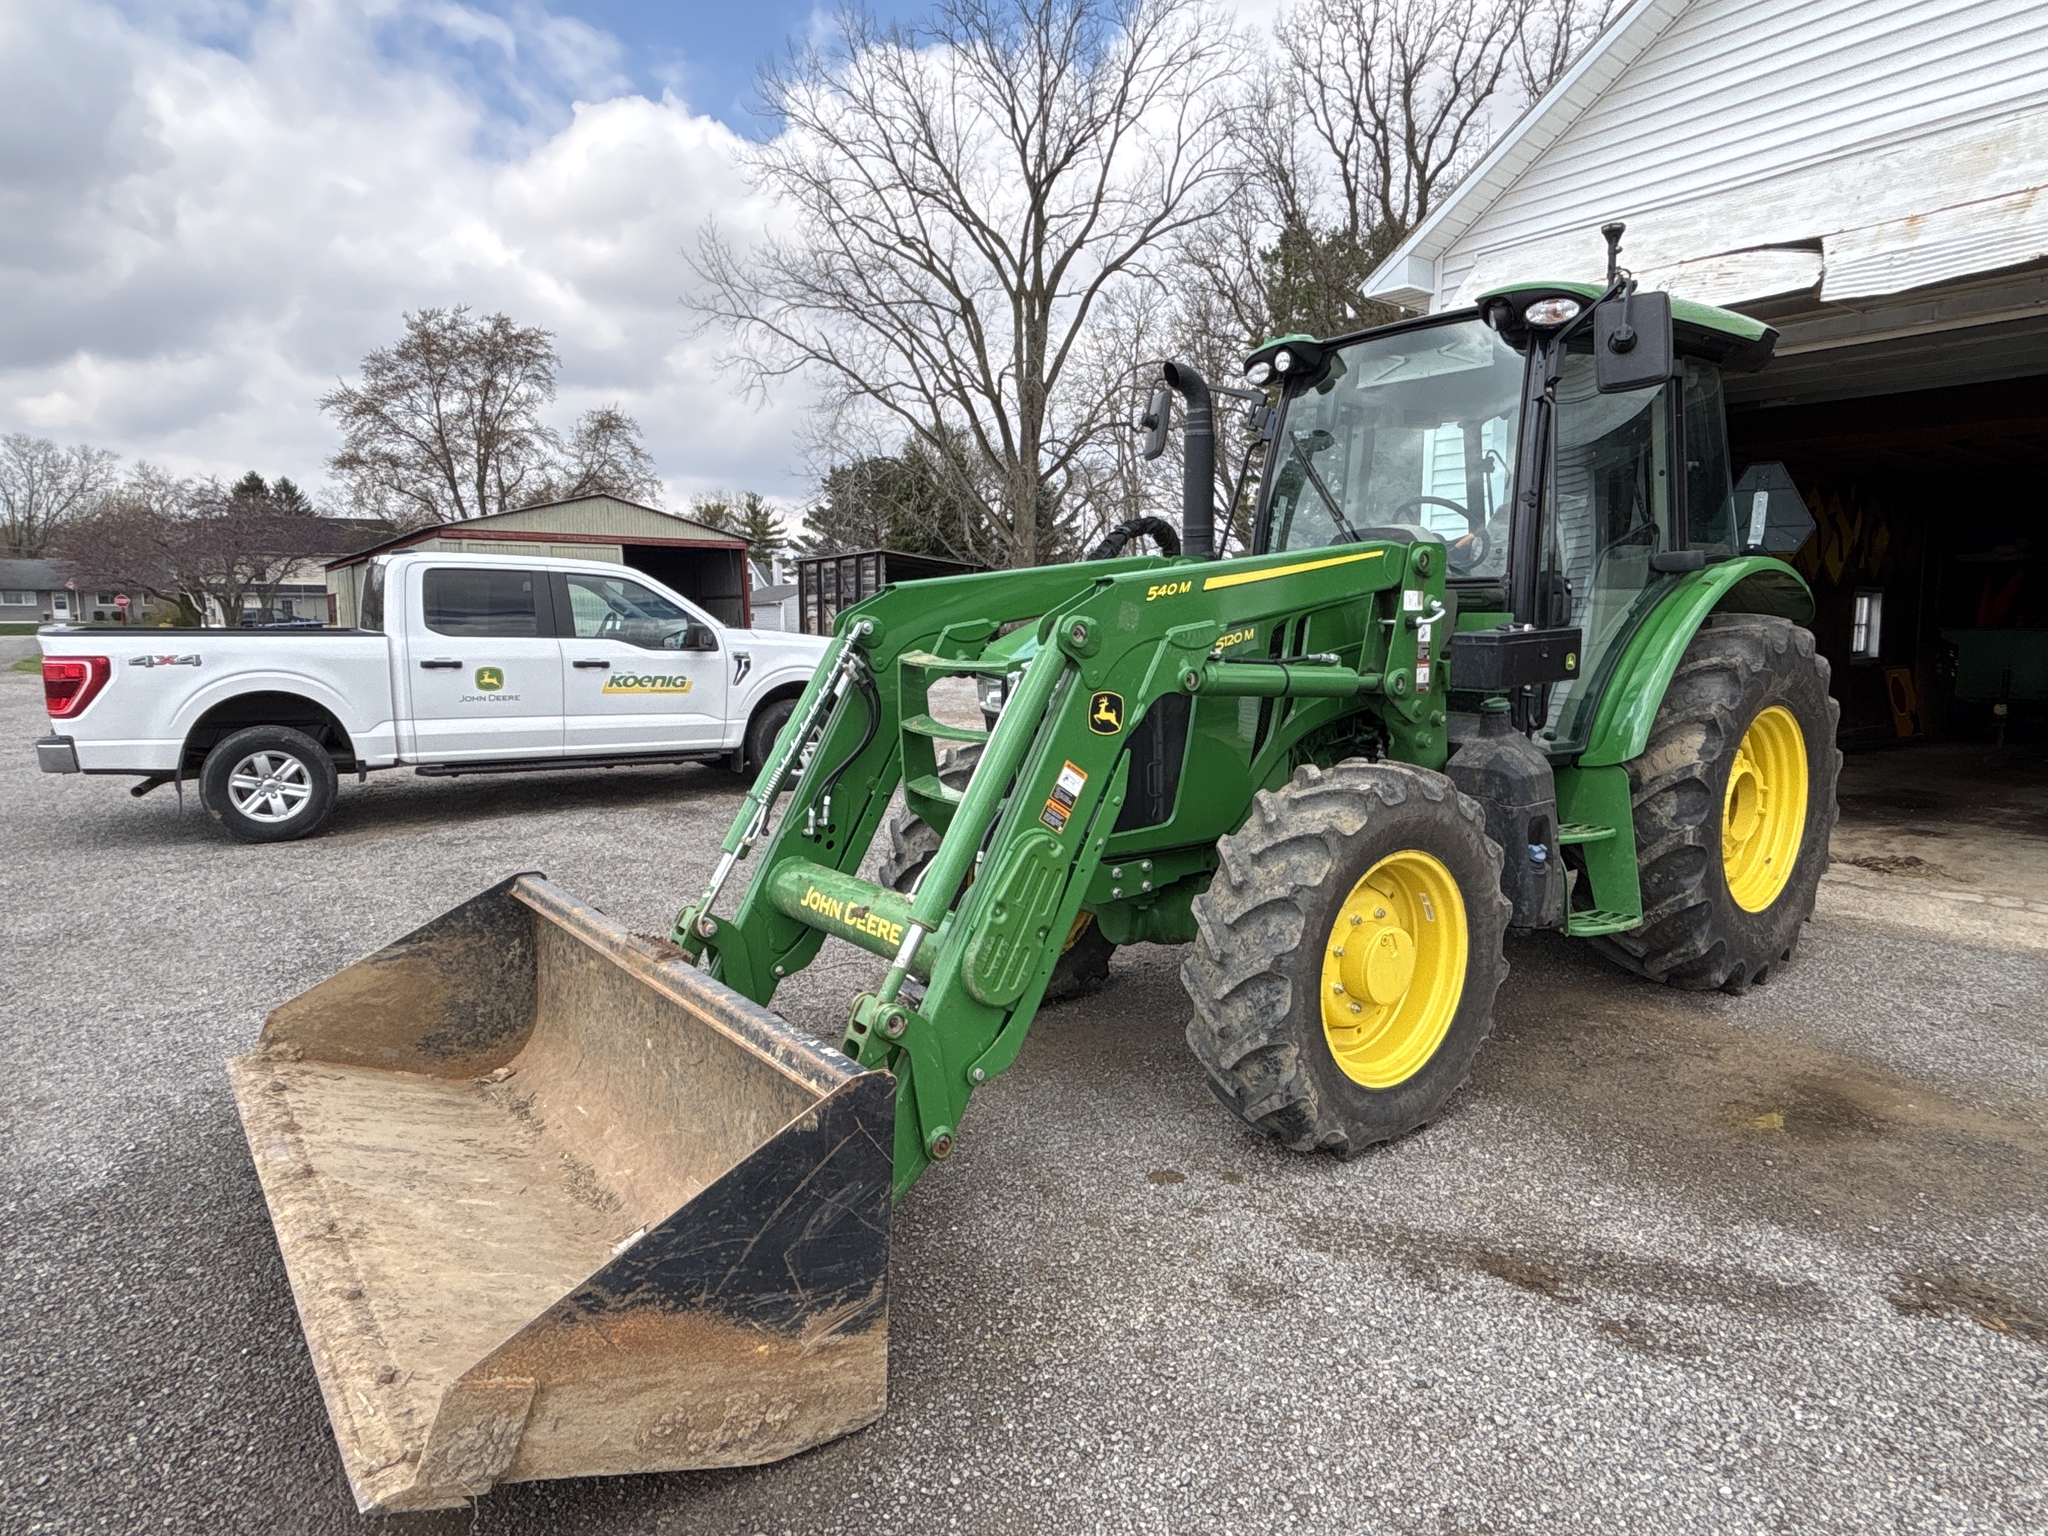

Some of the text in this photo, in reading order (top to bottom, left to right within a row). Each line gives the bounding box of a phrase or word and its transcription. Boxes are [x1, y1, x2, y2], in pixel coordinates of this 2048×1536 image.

[1146, 581, 1192, 602] 540 M
[1215, 628, 1255, 652] 5120 M
[129, 654, 202, 668] 4X4
[459, 694, 521, 702] JOHN DEERE
[801, 886, 903, 946] JOHN DEERE
